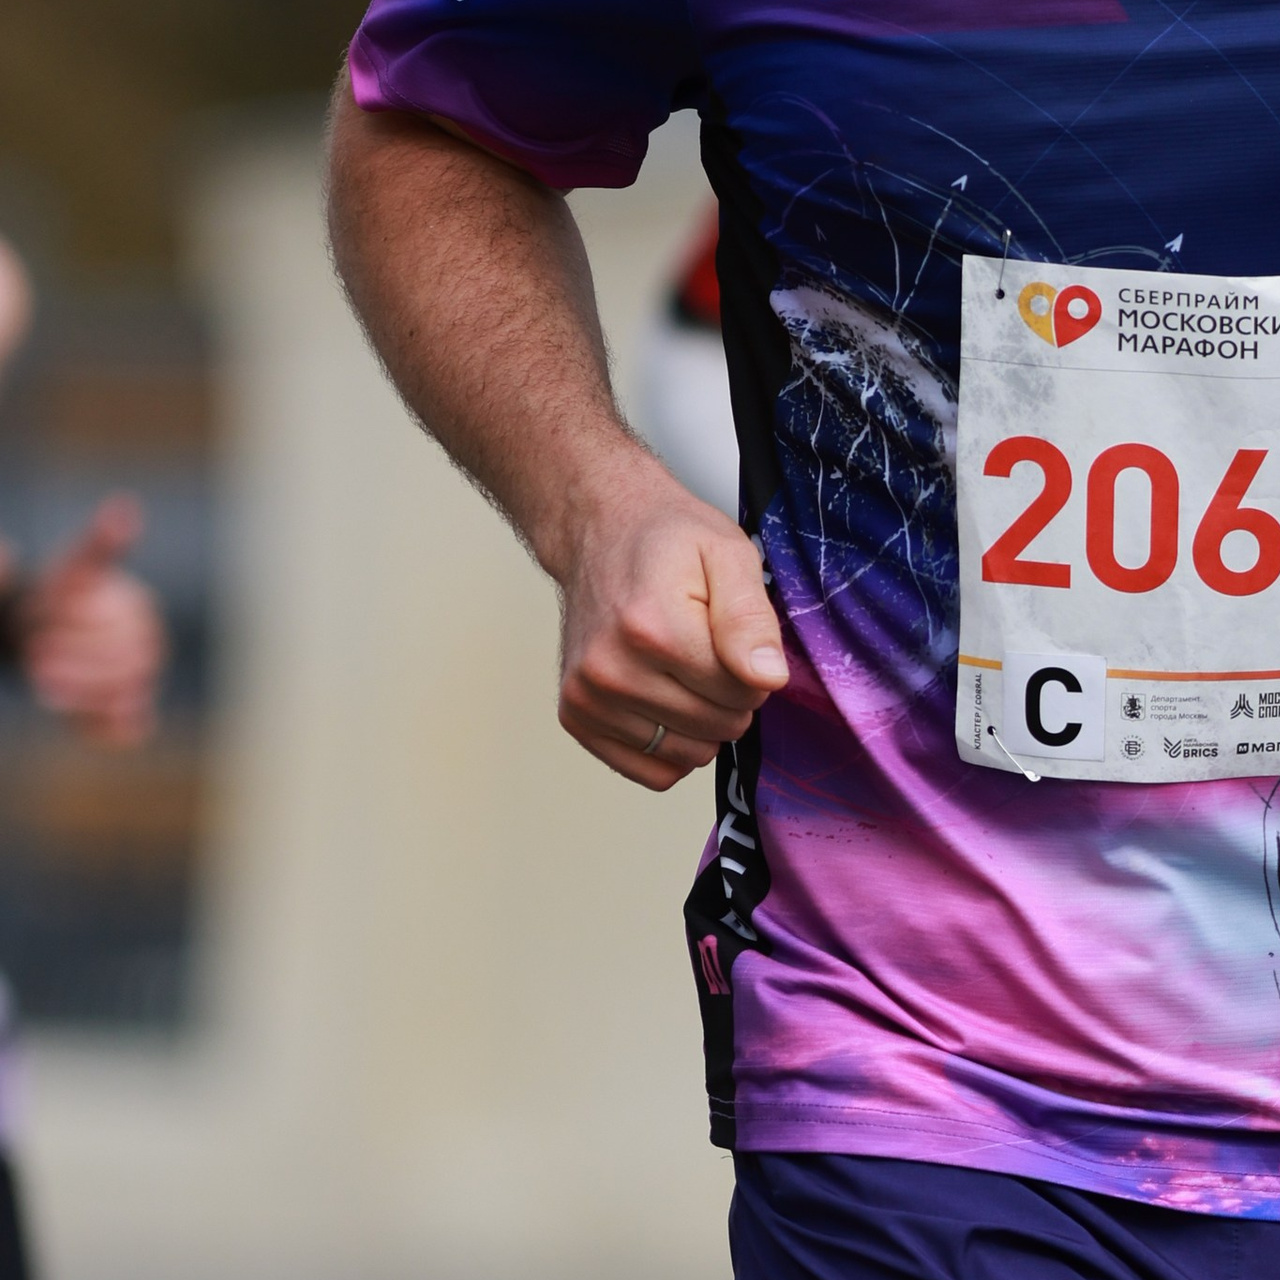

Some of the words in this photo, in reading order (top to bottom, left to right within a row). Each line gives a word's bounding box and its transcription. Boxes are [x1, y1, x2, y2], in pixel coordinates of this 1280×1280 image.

[1118, 288, 1259, 310] СБЕРПРАЙМ
[1118, 333, 1258, 359] МАРАФОН
[1150, 695, 1200, 703] Департамент
[1150, 705, 1176, 713] спорта
[1150, 713, 1176, 721] города
[974, 712, 982, 750] КЛАСТЕР
[1183, 748, 1218, 758] BRICS
